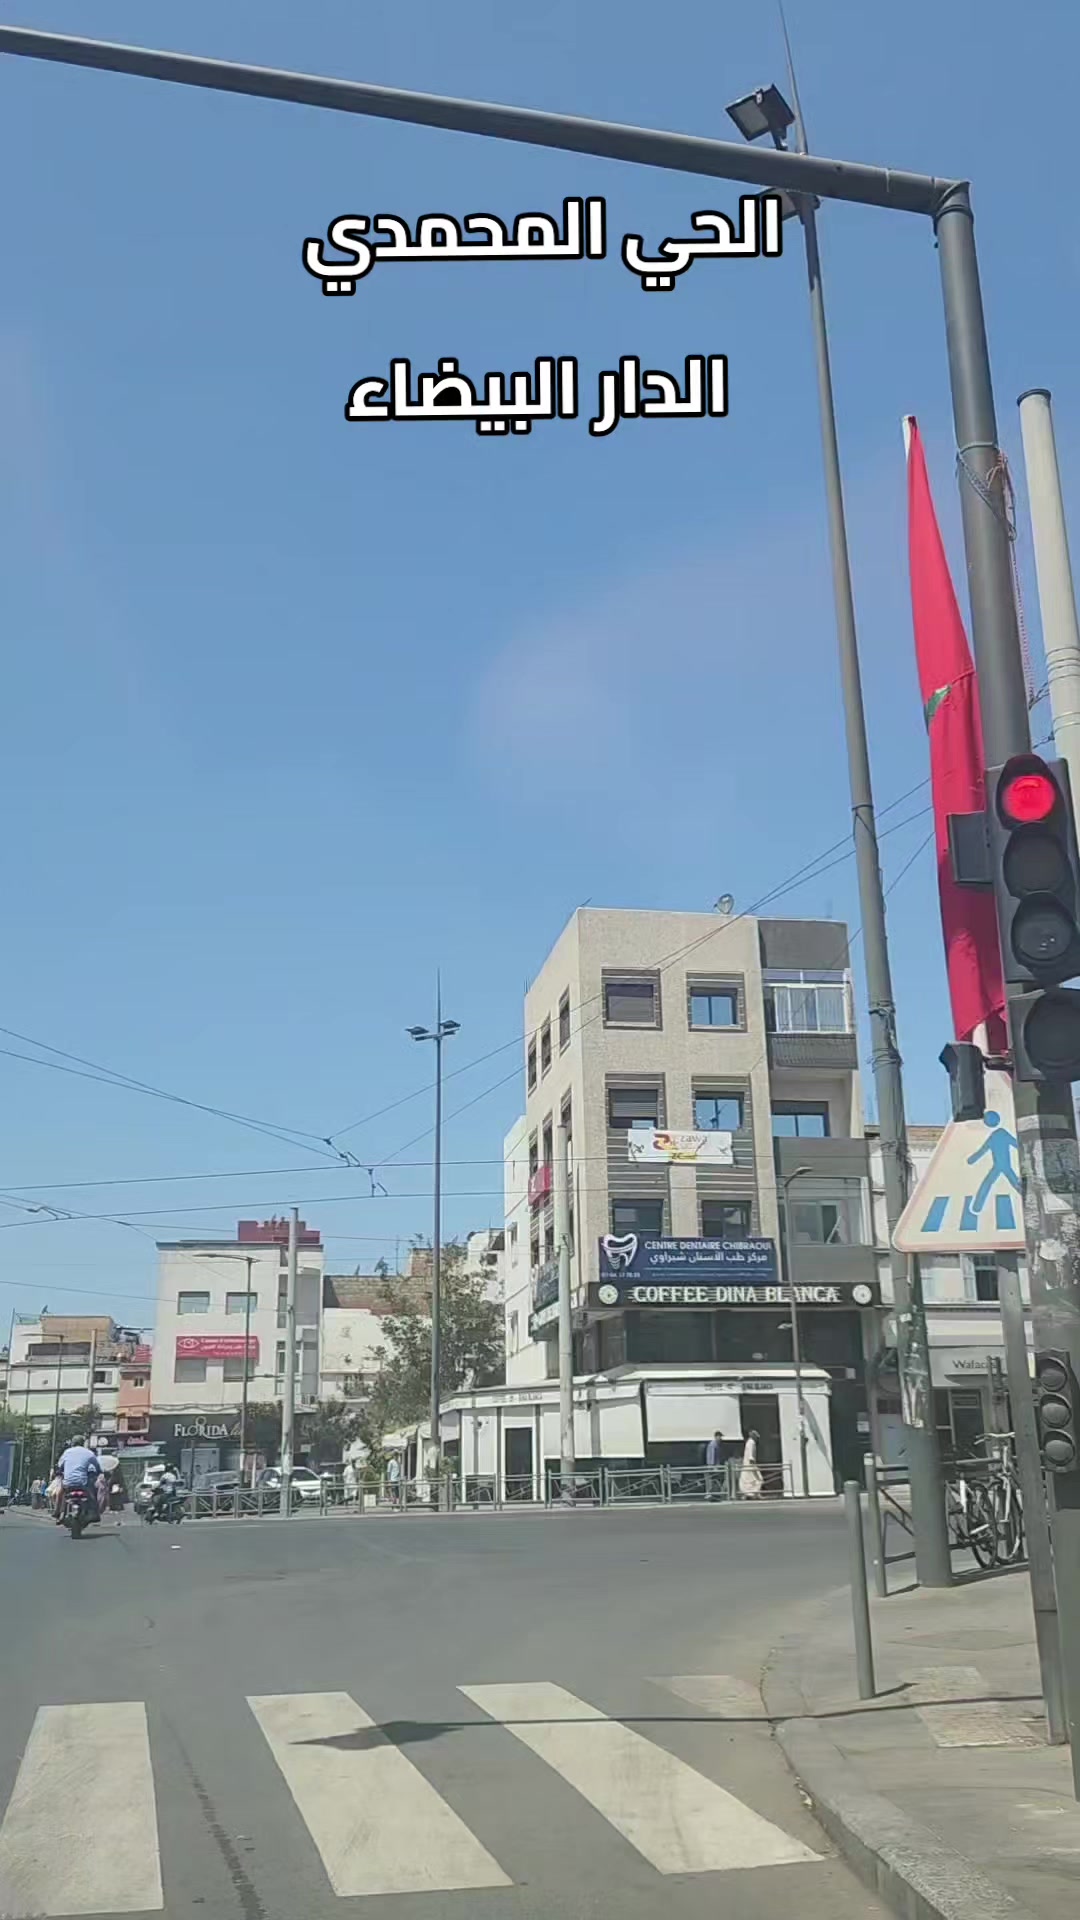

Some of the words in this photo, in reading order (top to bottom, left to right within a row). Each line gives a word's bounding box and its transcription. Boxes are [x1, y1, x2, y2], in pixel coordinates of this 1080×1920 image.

[644, 1241, 678, 1250] CENTRE
[679, 1241, 721, 1250] DENTAIRE
[722, 1241, 772, 1251] CHIBRAOUI
[726, 1252, 745, 1263] طب
[747, 1252, 768, 1263] مركز
[633, 1286, 708, 1303] COFFEE
[715, 1286, 758, 1303] DINA
[174, 1418, 229, 1439] FLORIDA
